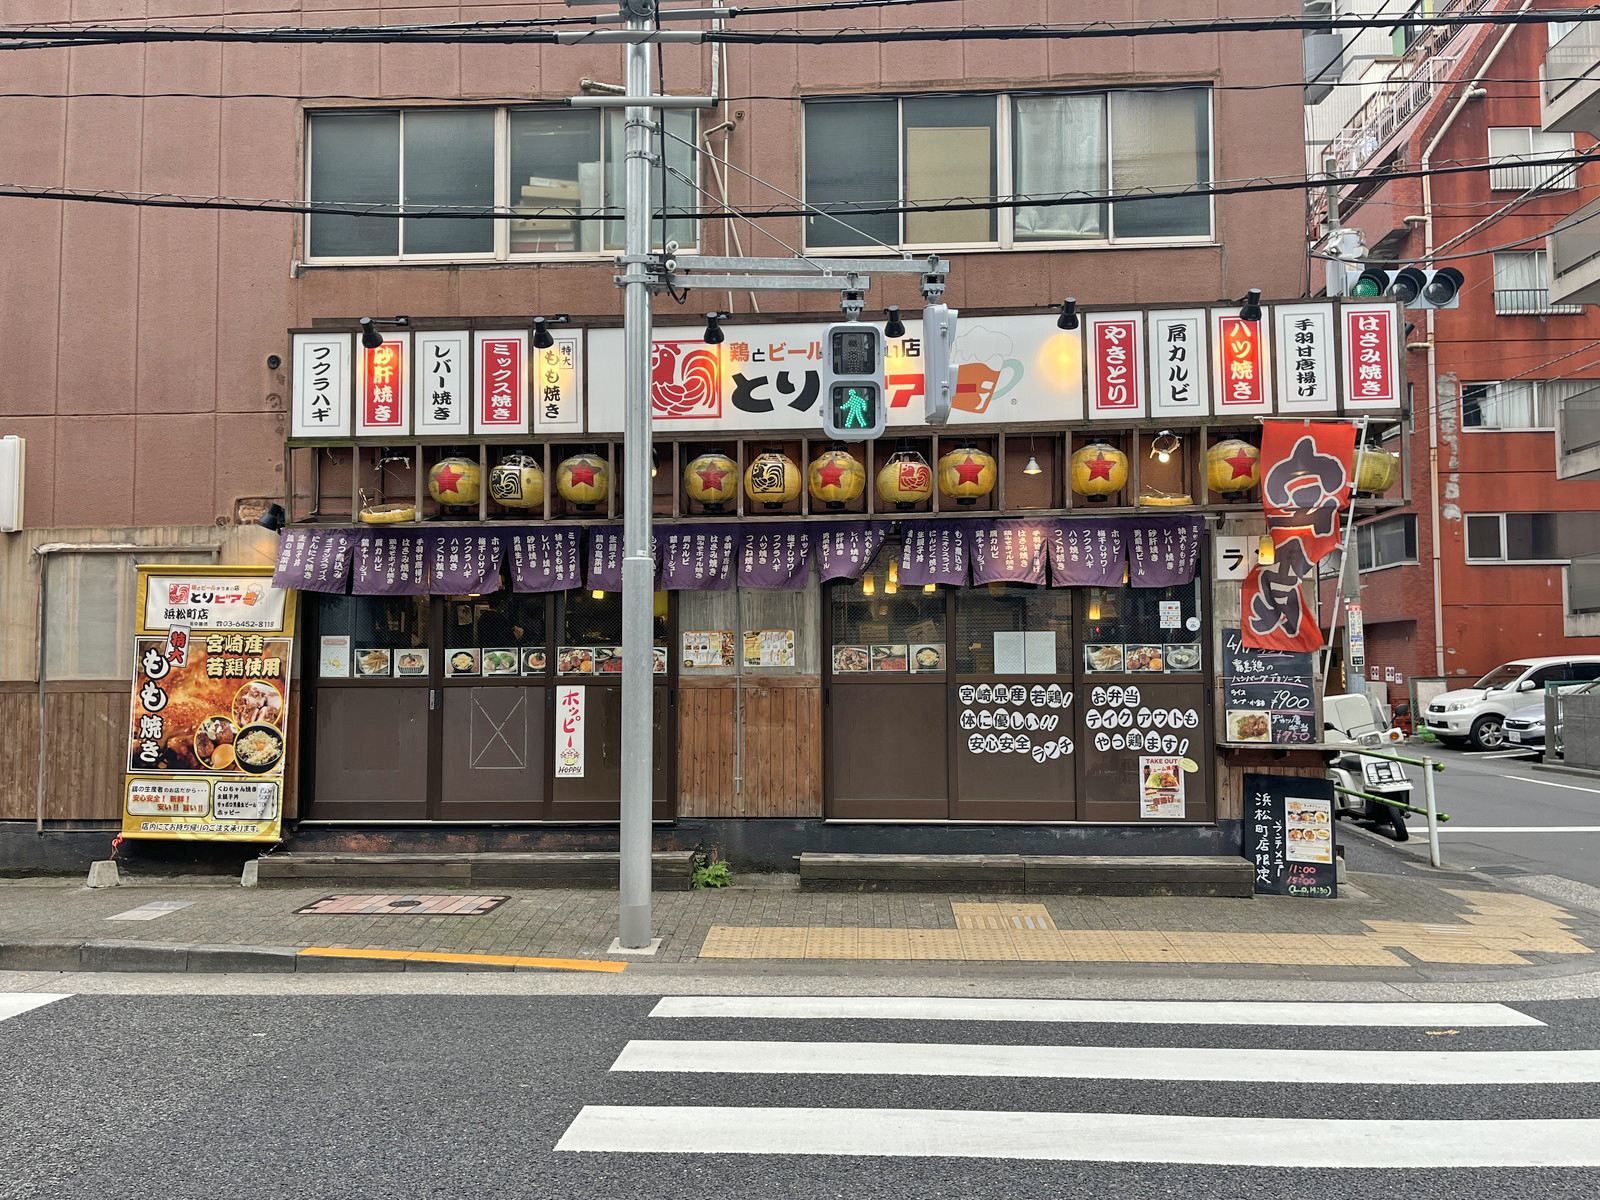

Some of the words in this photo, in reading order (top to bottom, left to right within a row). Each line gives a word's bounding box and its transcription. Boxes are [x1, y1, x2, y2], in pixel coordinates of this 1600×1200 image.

[561, 345, 572, 366] 特大
[1104, 326, 1128, 404] やきとり
[1167, 324, 1190, 402] 肩カルビ
[1230, 321, 1253, 399] ハツ焼き
[1295, 319, 1317, 398] 手羽甘唐揚げ
[1359, 316, 1382, 396] はさみ焼き
[312, 346, 332, 422] フクラハギ
[373, 345, 393, 422] 砂肝焼き
[432, 344, 452, 420] レバー焼き
[491, 344, 512, 419] ミックス焼き
[543, 348, 561, 419] もも焼き
[436, 537, 445, 579] つくね焼き
[449, 538, 459, 571] ハツ焼き
[463, 537, 472, 578] フクラハギ
[541, 534, 550, 575] レバー焼き
[744, 535, 754, 572] つくね焼き
[759, 534, 768, 564] ハツ焼き
[772, 534, 781, 571] フクラハギ
[1055, 529, 1065, 570] つくね焼き
[1069, 530, 1079, 561] ハツ焼き
[1082, 530, 1094, 568] フクラハギ
[1163, 529, 1174, 570] レバー焼き
[164, 608, 209, 620] 浜松町店
[168, 631, 186, 663] 特大
[206, 634, 264, 655] 宮崎産
[206, 657, 281, 679] 若鶏使用
[139, 649, 171, 764] もも焼き
[960, 687, 1026, 703] 宮崎県産
[1092, 687, 1140, 706] お弁当
[562, 688, 581, 748] ホッピー
[961, 710, 1058, 730] 体に優しい!!
[969, 735, 1030, 752] 安心安全
[1033, 737, 1073, 761] ランチ
[1096, 730, 1188, 755] やっ鶏ます!
[1254, 792, 1272, 884] 浜松町店限定
[1289, 864, 1316, 874] 11:00
